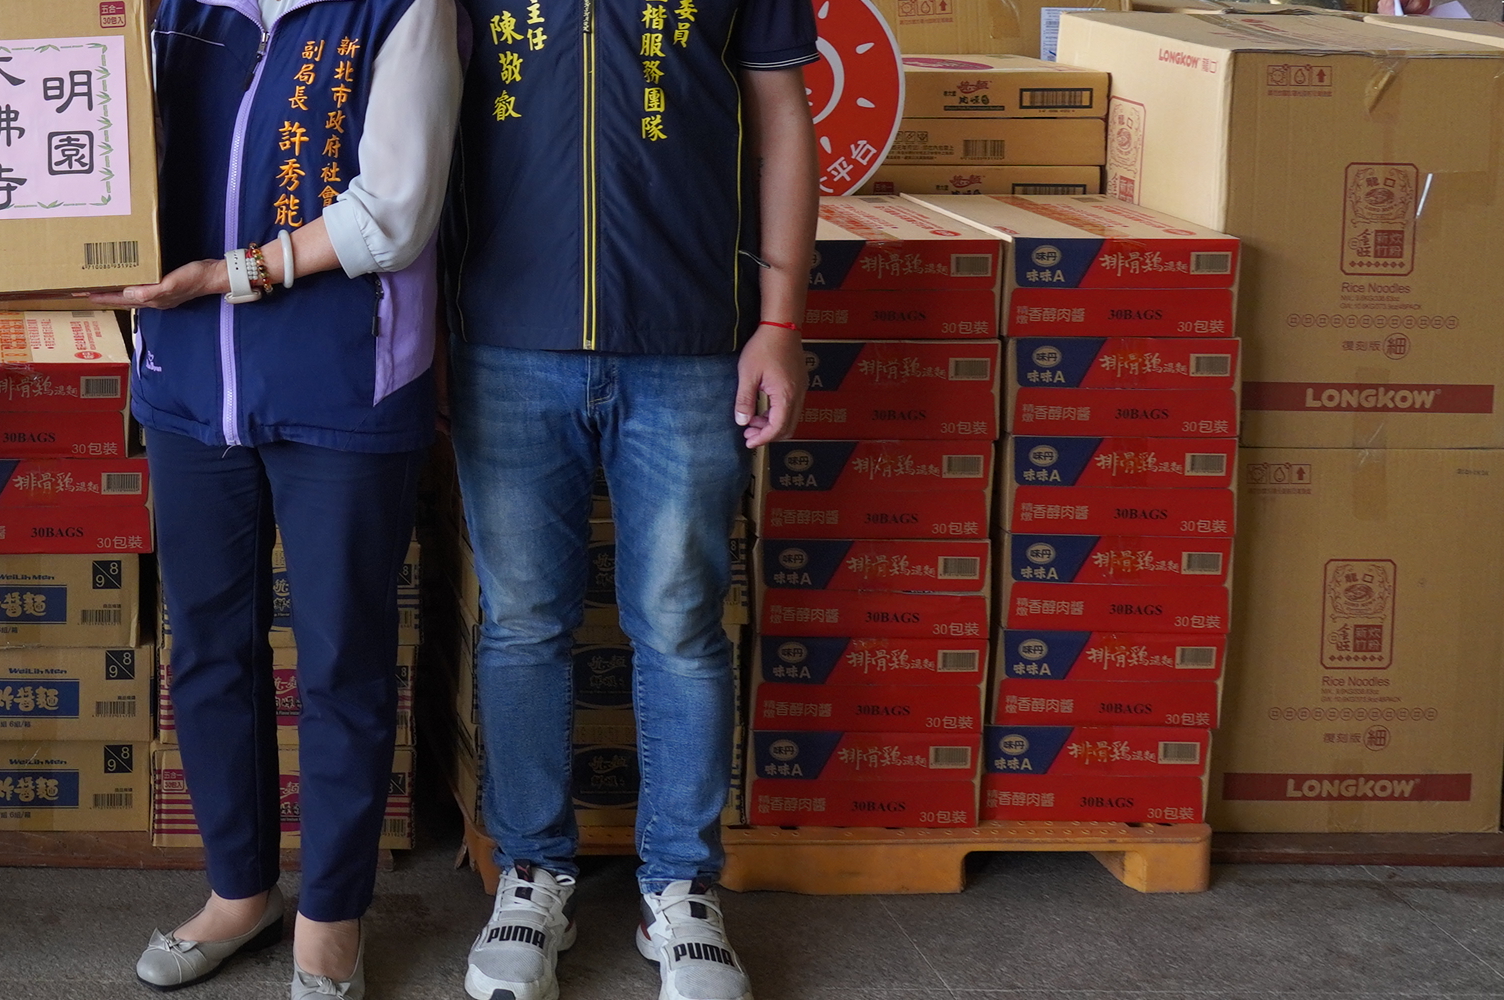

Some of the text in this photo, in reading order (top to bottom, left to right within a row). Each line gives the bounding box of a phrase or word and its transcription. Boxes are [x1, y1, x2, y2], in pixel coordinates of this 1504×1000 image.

[101, 4, 124, 14] 五合一
[1158, 48, 1199, 69] LONGKOW
[42, 70, 94, 176] 明園
[274, 39, 325, 228] 副局長 許秀能
[1026, 269, 1065, 282] 味味A
[1341, 282, 1411, 294] Rice Noodles
[872, 310, 927, 322] 30BAGS
[1108, 309, 1163, 321] 30BAGS
[1177, 320, 1225, 334] 30包裝
[1305, 388, 1437, 409] LONGKOW
[3, 432, 56, 443] 30BAGS
[72, 443, 118, 455] 30包裝
[779, 473, 817, 487] 味味A
[864, 513, 918, 525] 30BAGS
[31, 527, 84, 538] 30BAGS
[1181, 519, 1227, 534] 30包裝
[97, 536, 143, 549] 30包裝
[109, 563, 119, 575] 8
[96, 575, 105, 587] 9
[1322, 676, 1390, 687] Rice Noodles
[1285, 778, 1415, 798] LONGKOW
[1080, 797, 1134, 810] 30BAGS
[1147, 807, 1194, 821] 30包裝
[487, 926, 546, 950] PUMA
[673, 942, 735, 967] PUMA
